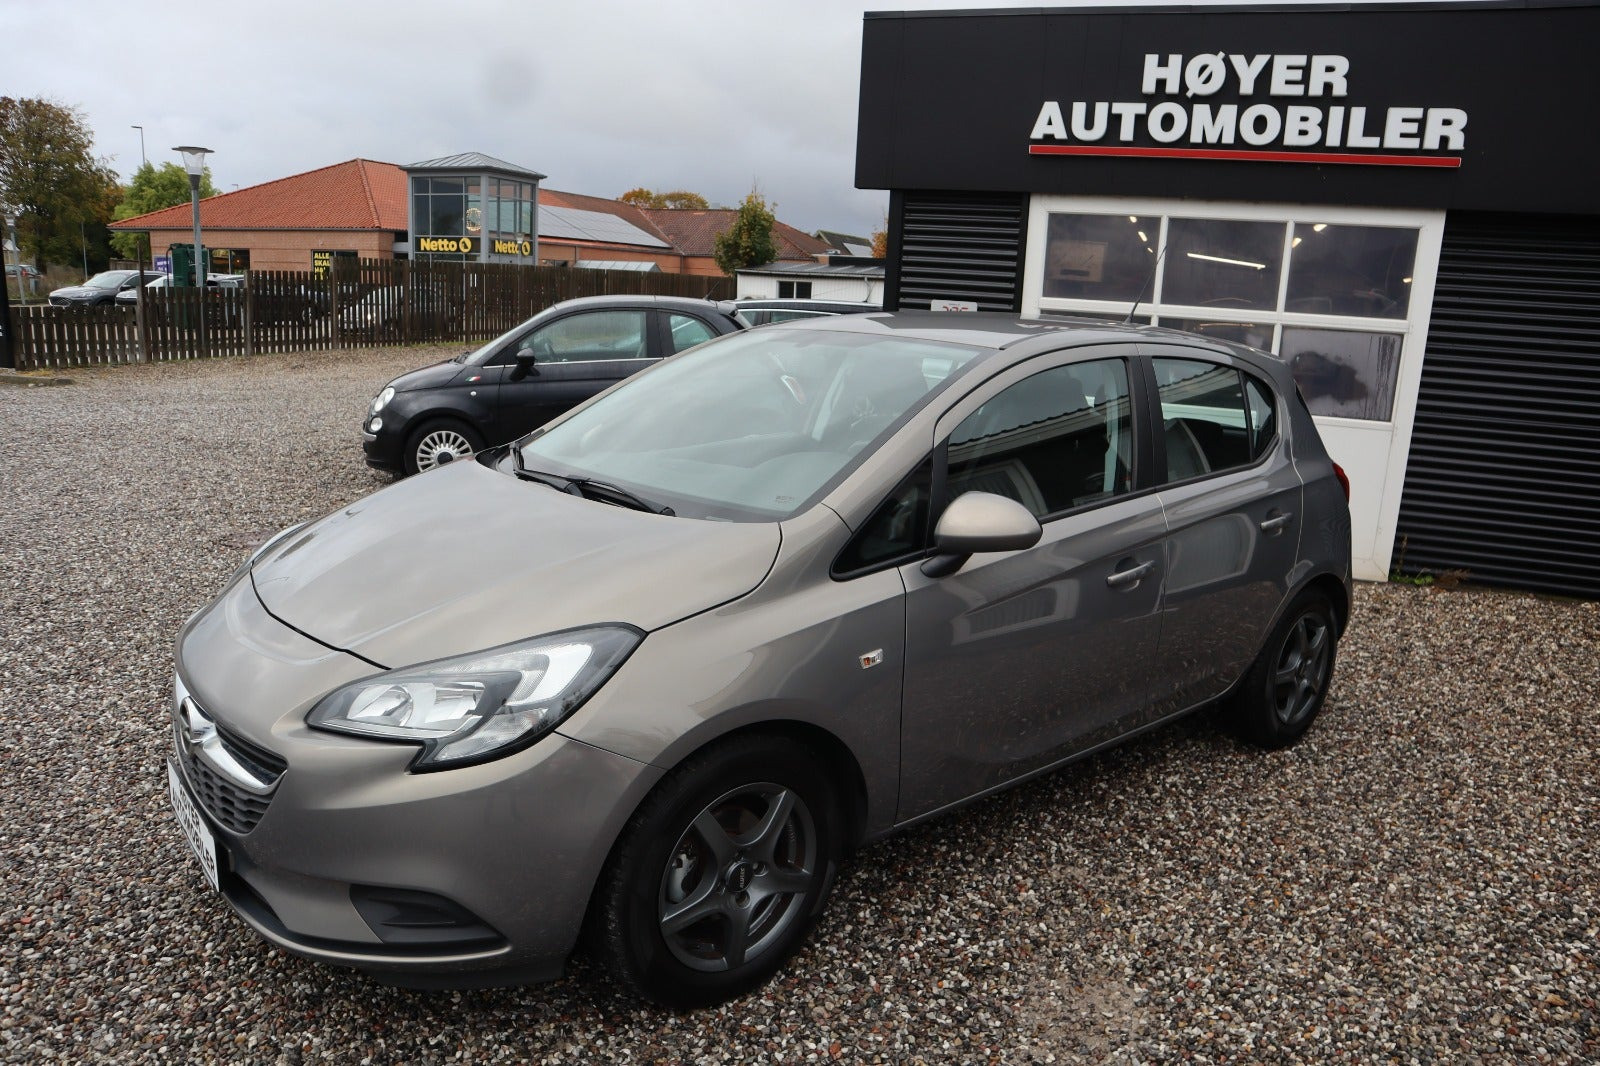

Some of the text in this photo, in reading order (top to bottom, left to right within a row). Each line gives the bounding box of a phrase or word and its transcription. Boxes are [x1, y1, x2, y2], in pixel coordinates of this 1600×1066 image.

[1142, 51, 1350, 98] HØYER
[1029, 101, 1469, 151] AUTOMOBILER
[420, 238, 458, 252] Netto
